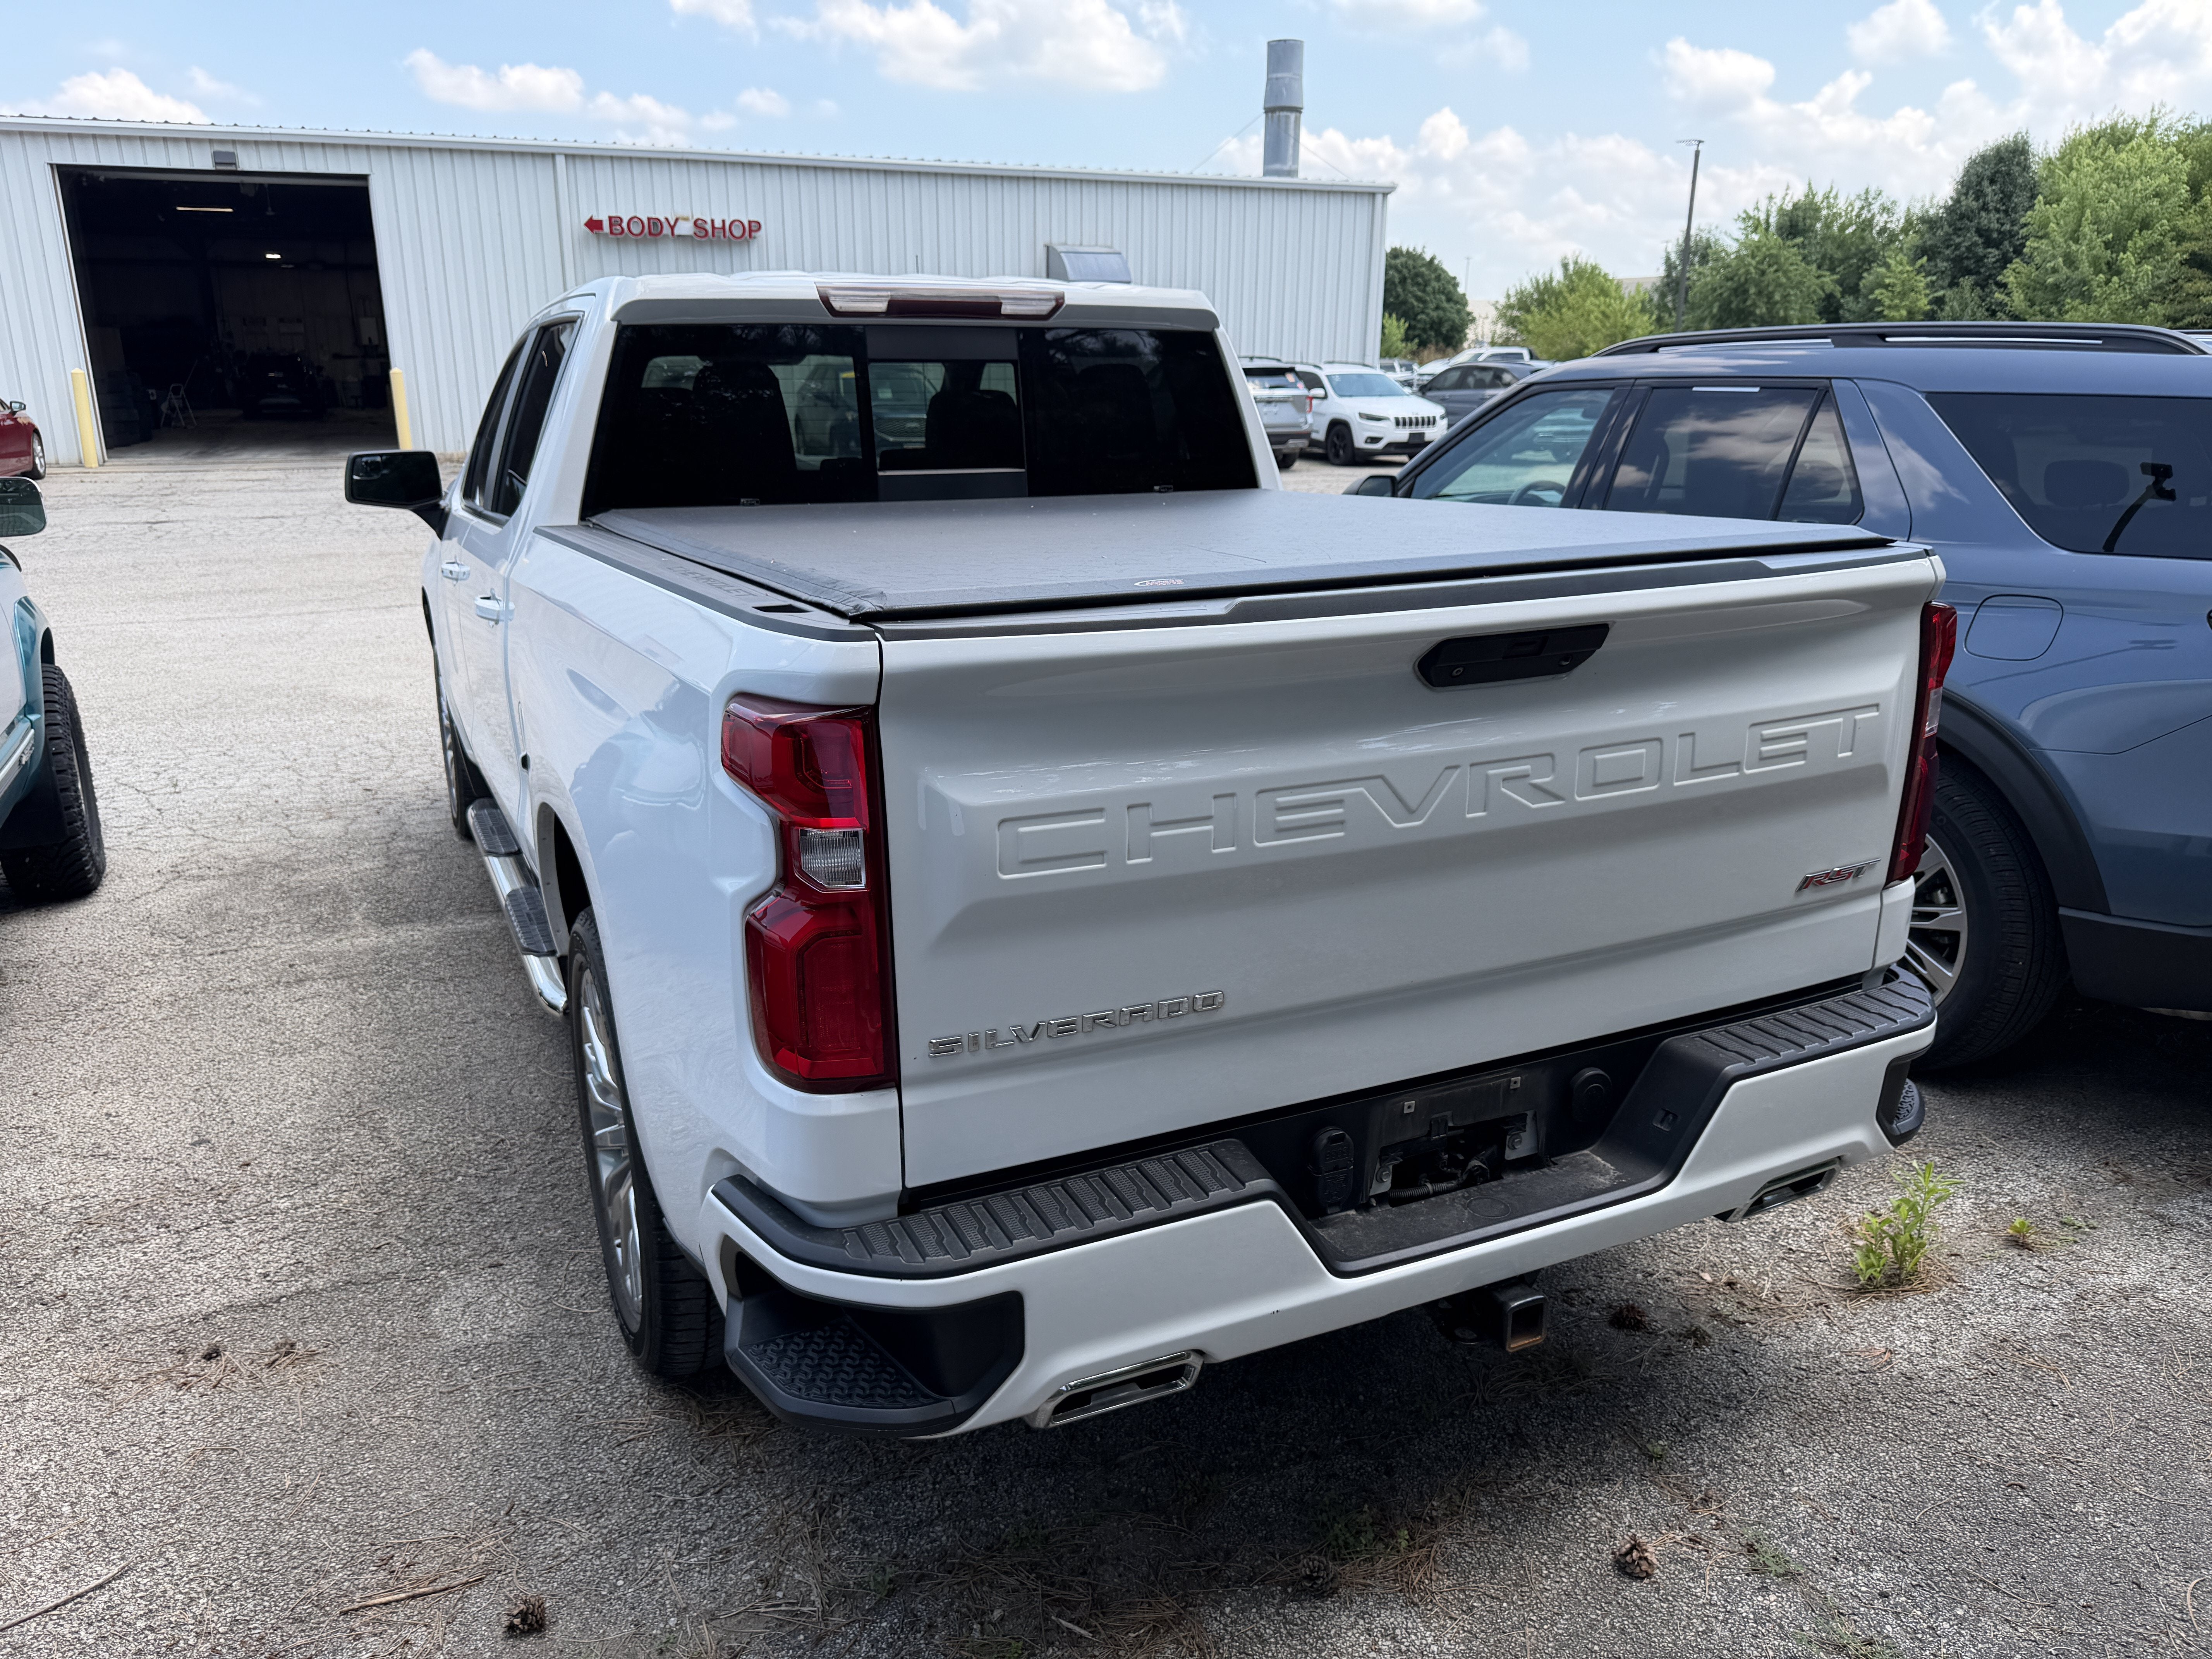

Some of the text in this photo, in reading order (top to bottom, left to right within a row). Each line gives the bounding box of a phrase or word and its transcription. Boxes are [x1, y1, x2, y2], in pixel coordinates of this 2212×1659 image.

[608, 215, 762, 239] BODY SHOP
[996, 703, 1879, 880] CHEVROLET
[1795, 858, 1881, 891] RST
[929, 990, 1224, 1058] SILVERADO
